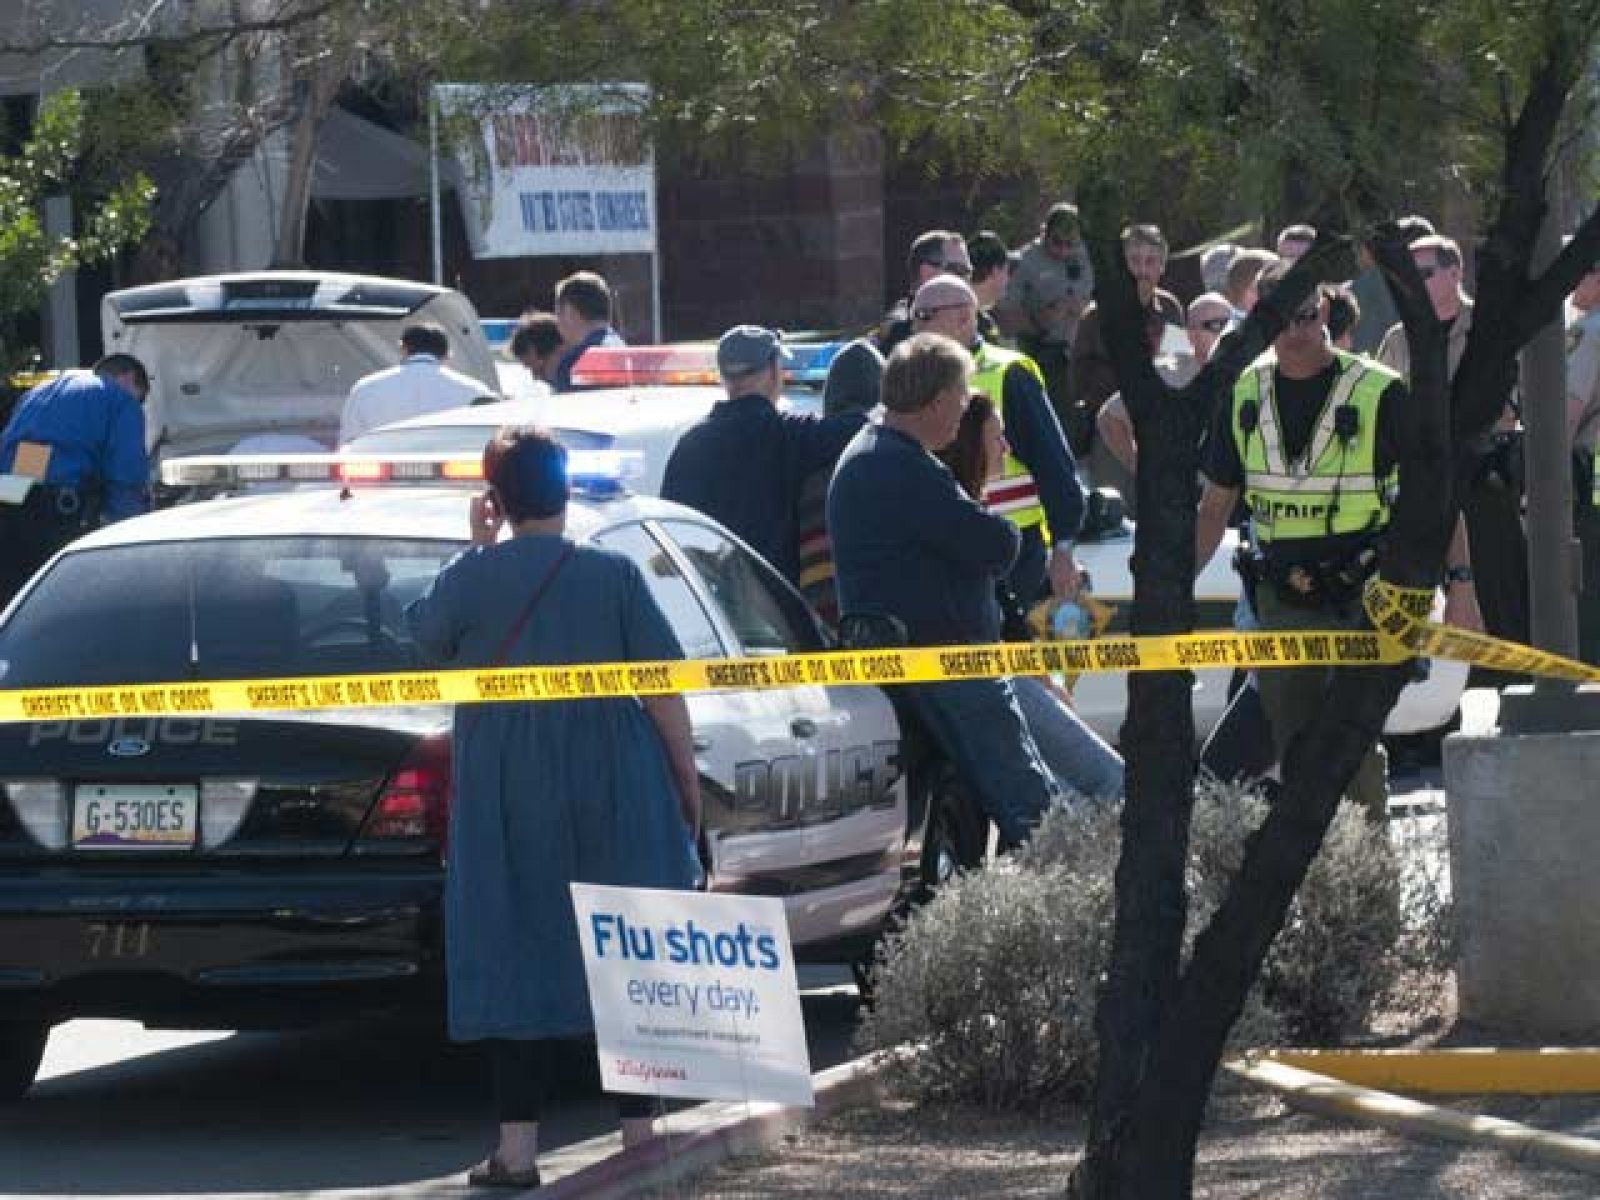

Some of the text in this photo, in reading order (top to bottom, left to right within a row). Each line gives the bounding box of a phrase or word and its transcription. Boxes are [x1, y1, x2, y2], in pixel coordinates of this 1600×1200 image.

[1008, 647, 1041, 671] LINE
[1042, 647, 1063, 670] DO
[1065, 645, 1092, 668] NOT
[1095, 642, 1140, 667] CROSS
[1245, 637, 1278, 661] LINE
[1280, 636, 1299, 661] DO
[1303, 635, 1331, 661] NOT
[1334, 635, 1380, 661] CROSS
[542, 672, 575, 695] LINE
[576, 670, 595, 693] DO
[597, 669, 623, 692] NOT
[630, 665, 672, 690] CROSS
[774, 659, 806, 683] LINE
[807, 659, 828, 681] DO
[830, 657, 856, 680] NOT
[860, 654, 905, 679] CROSS
[88, 692, 119, 713] LINE
[120, 691, 139, 712] DO
[141, 690, 164, 712] NOT
[170, 687, 213, 711] CROSS
[312, 682, 345, 705] LINE
[348, 682, 366, 703] DO
[369, 679, 394, 702] NOT
[399, 677, 441, 700] CROSS
[86, 800, 183, 831] G-530ES
[589, 912, 781, 971] Flu shots
[627, 979, 698, 1017] every
